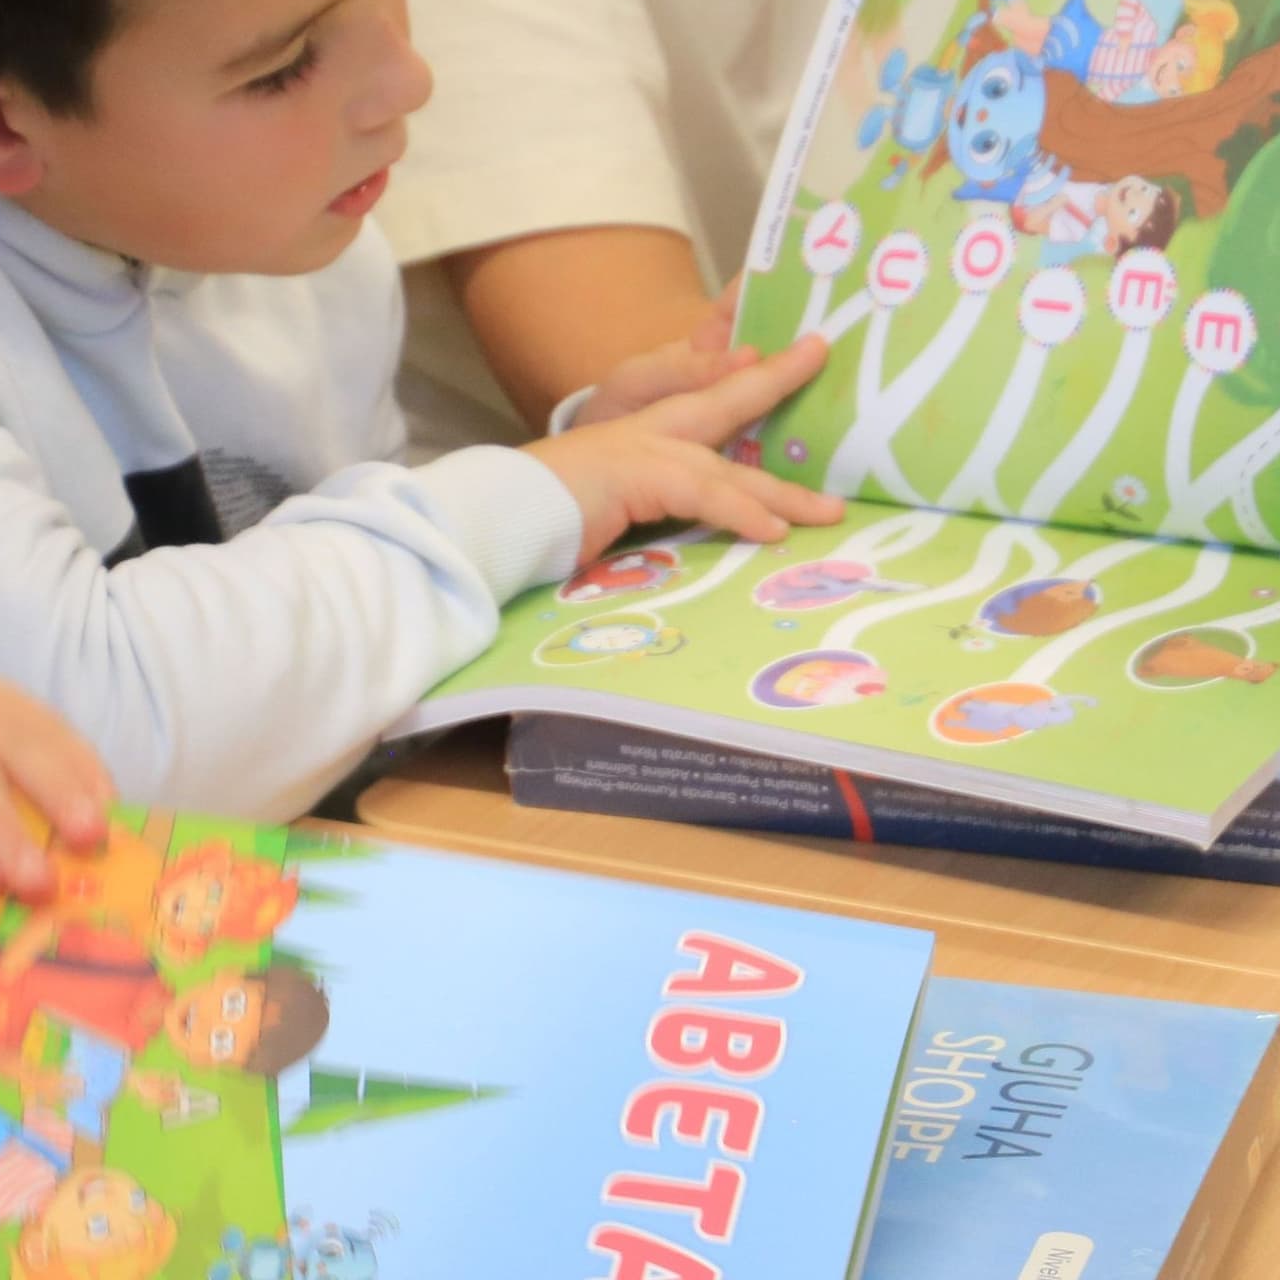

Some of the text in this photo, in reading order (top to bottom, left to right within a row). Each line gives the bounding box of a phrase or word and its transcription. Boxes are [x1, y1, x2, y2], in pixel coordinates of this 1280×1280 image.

[813, 214, 848, 250] Y
[877, 250, 918, 290] U
[962, 231, 1003, 277] O
[1032, 299, 1072, 312] I
[1120, 270, 1177, 310] Ë
[1196, 312, 1241, 352] E
[961, 1043, 1094, 1160] GJUHA
[1039, 1248, 1075, 1280] Nivel
